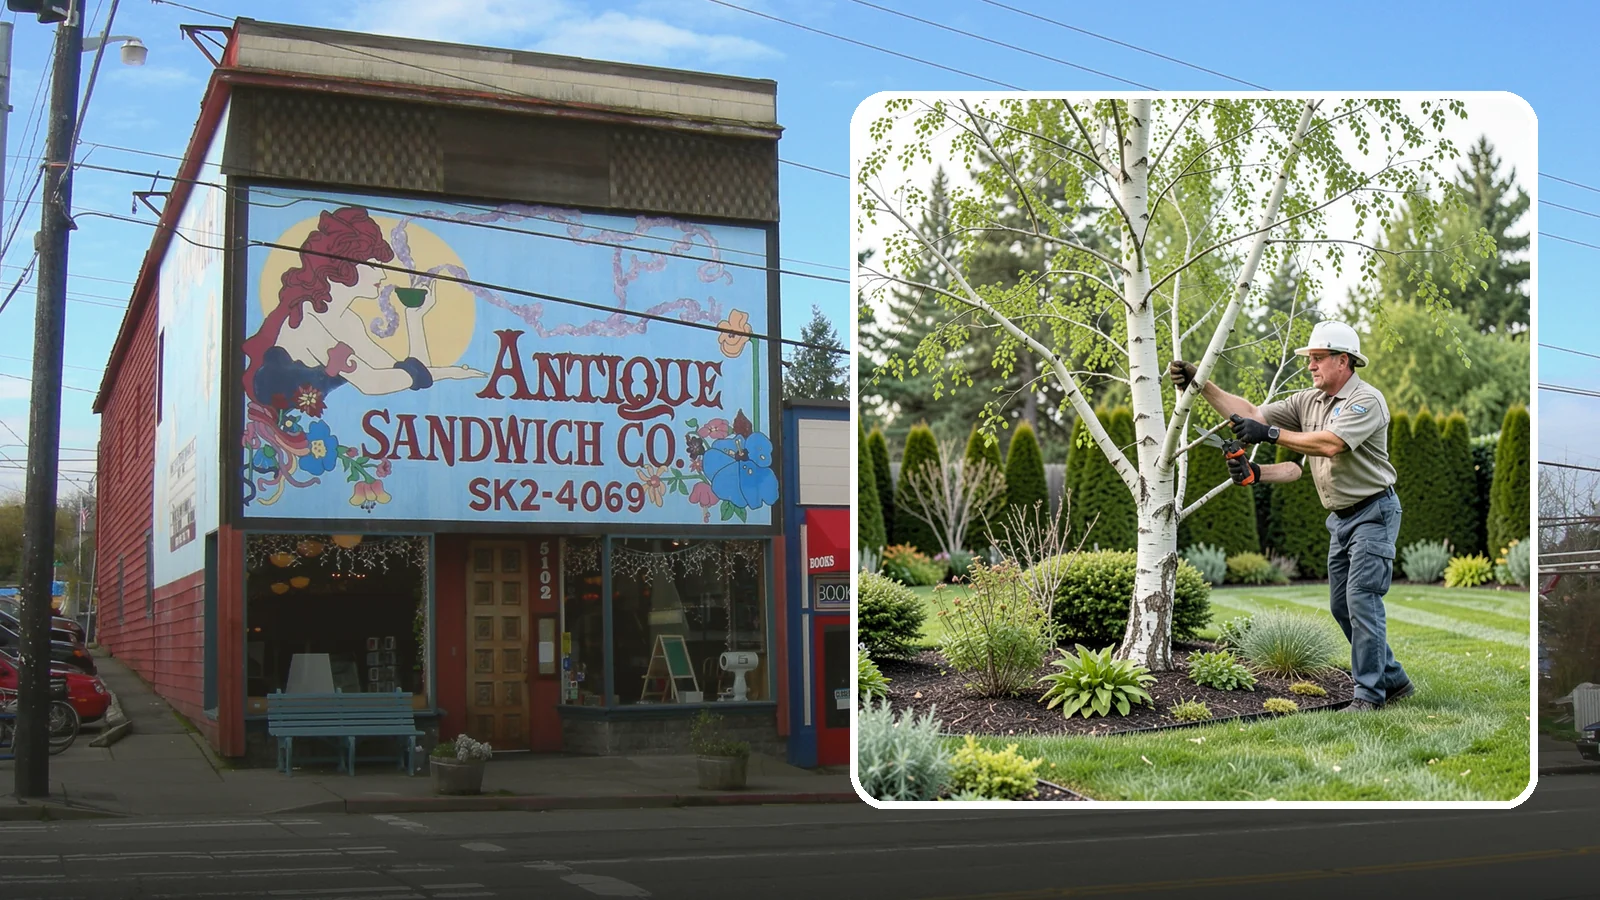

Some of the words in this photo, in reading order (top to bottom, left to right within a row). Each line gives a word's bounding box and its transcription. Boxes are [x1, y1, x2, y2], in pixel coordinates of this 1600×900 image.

[476, 329, 724, 420] ANTIQUE
[361, 408, 604, 468] SANDWICH
[617, 422, 685, 469] CO.
[468, 477, 645, 513] SK2-4069
[540, 541, 552, 600] 5102
[809, 555, 835, 569] BOOKS
